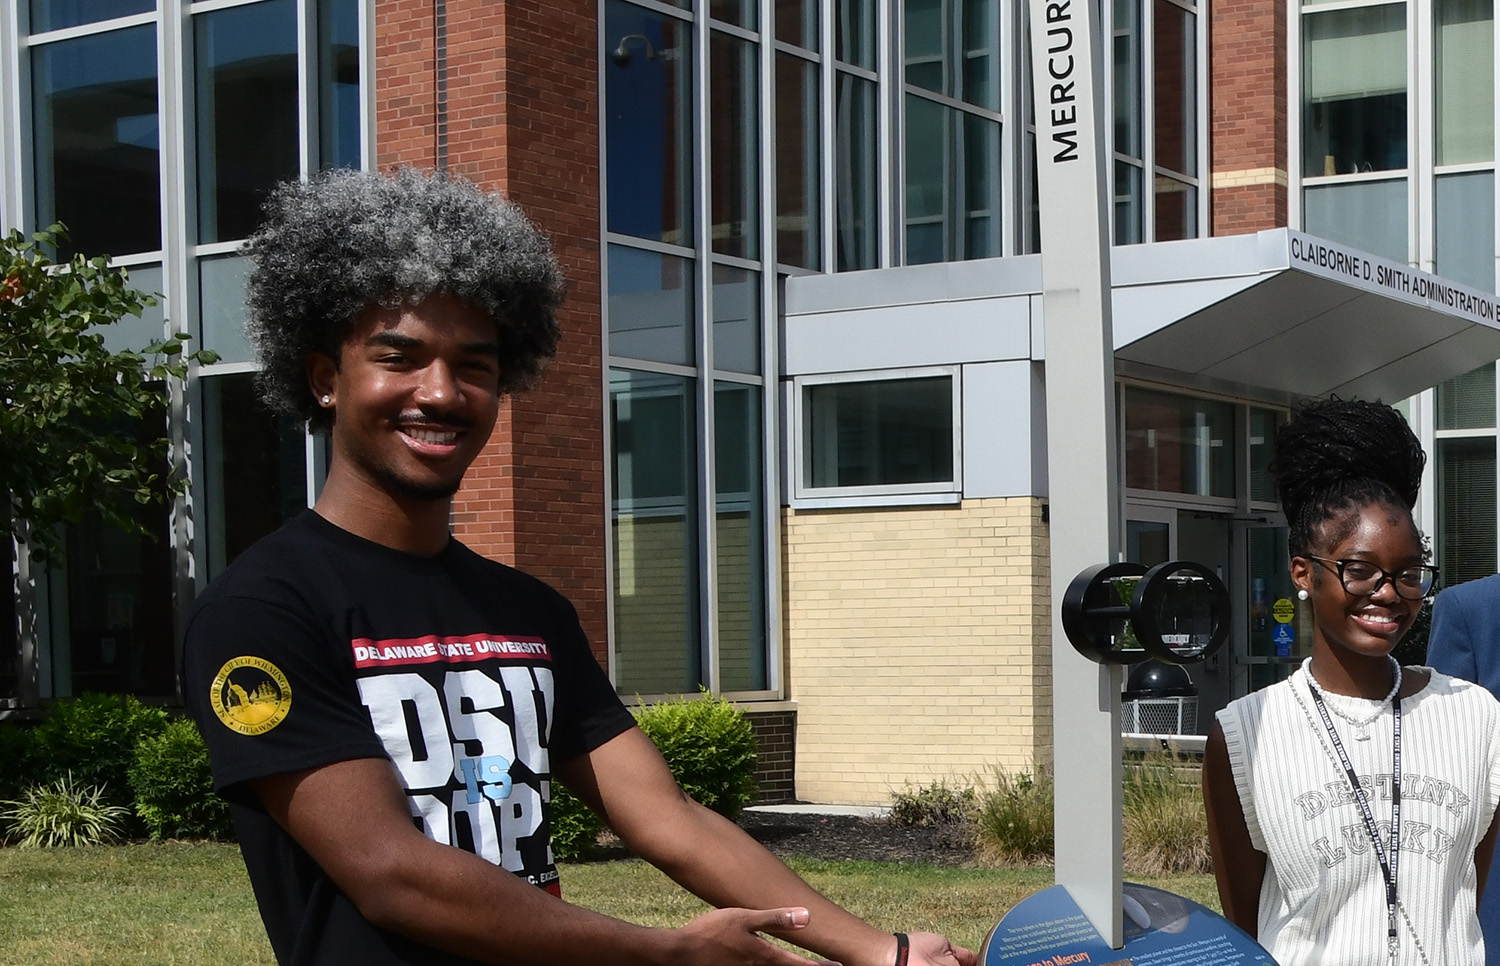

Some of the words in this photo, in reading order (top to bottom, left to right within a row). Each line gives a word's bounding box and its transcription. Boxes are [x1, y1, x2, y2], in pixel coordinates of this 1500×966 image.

[1046, 0, 1079, 164] MERCUR
[1291, 238, 1360, 278] CLAIBORNE
[1363, 261, 1374, 282] D.
[1377, 265, 1410, 292] SMITH
[1412, 279, 1494, 320] ADMINISTRATION
[354, 642, 437, 661] DELAWARE
[438, 643, 474, 657] STATE
[475, 640, 549, 655] UNIVERSITY
[355, 666, 555, 790] DSU
[460, 755, 513, 805] IS
[1294, 773, 1471, 821] DESTINY
[405, 780, 554, 872] DOP
[1312, 819, 1456, 869] LUCKY
[1052, 952, 1092, 966] Mercury
